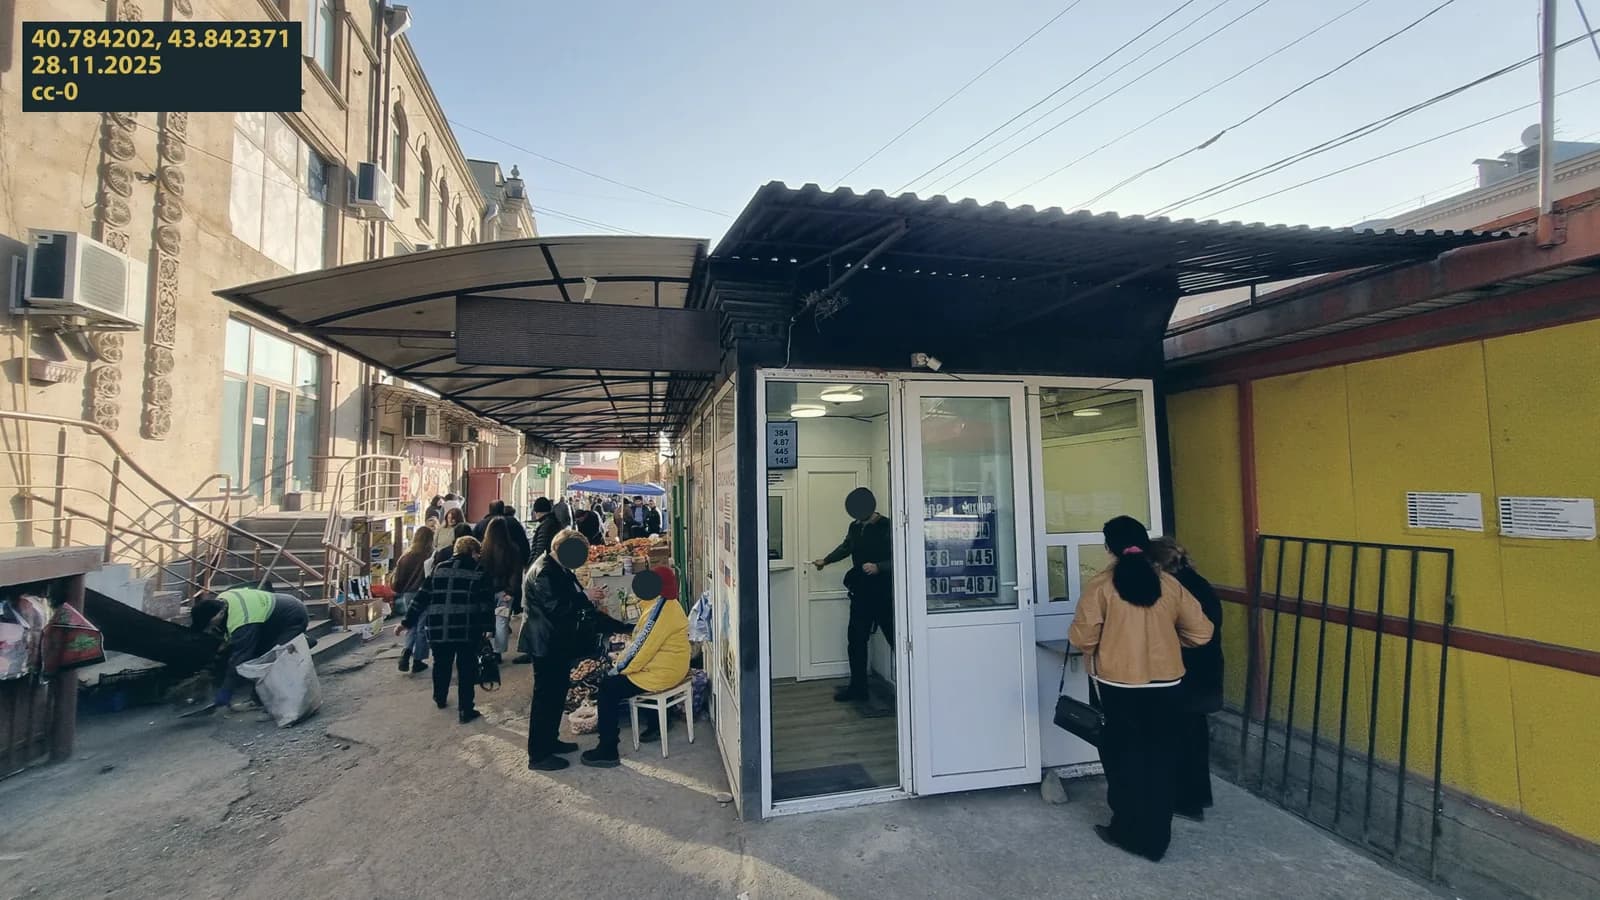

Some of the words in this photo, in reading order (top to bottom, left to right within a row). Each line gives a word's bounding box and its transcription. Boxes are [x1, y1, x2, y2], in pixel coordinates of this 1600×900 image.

[774, 429, 788, 437] 384
[773, 438, 790, 446] 4.87
[774, 447, 789, 455] 445
[775, 457, 789, 465] 145
[967, 549, 993, 565] 445
[966, 576, 994, 592] 487
